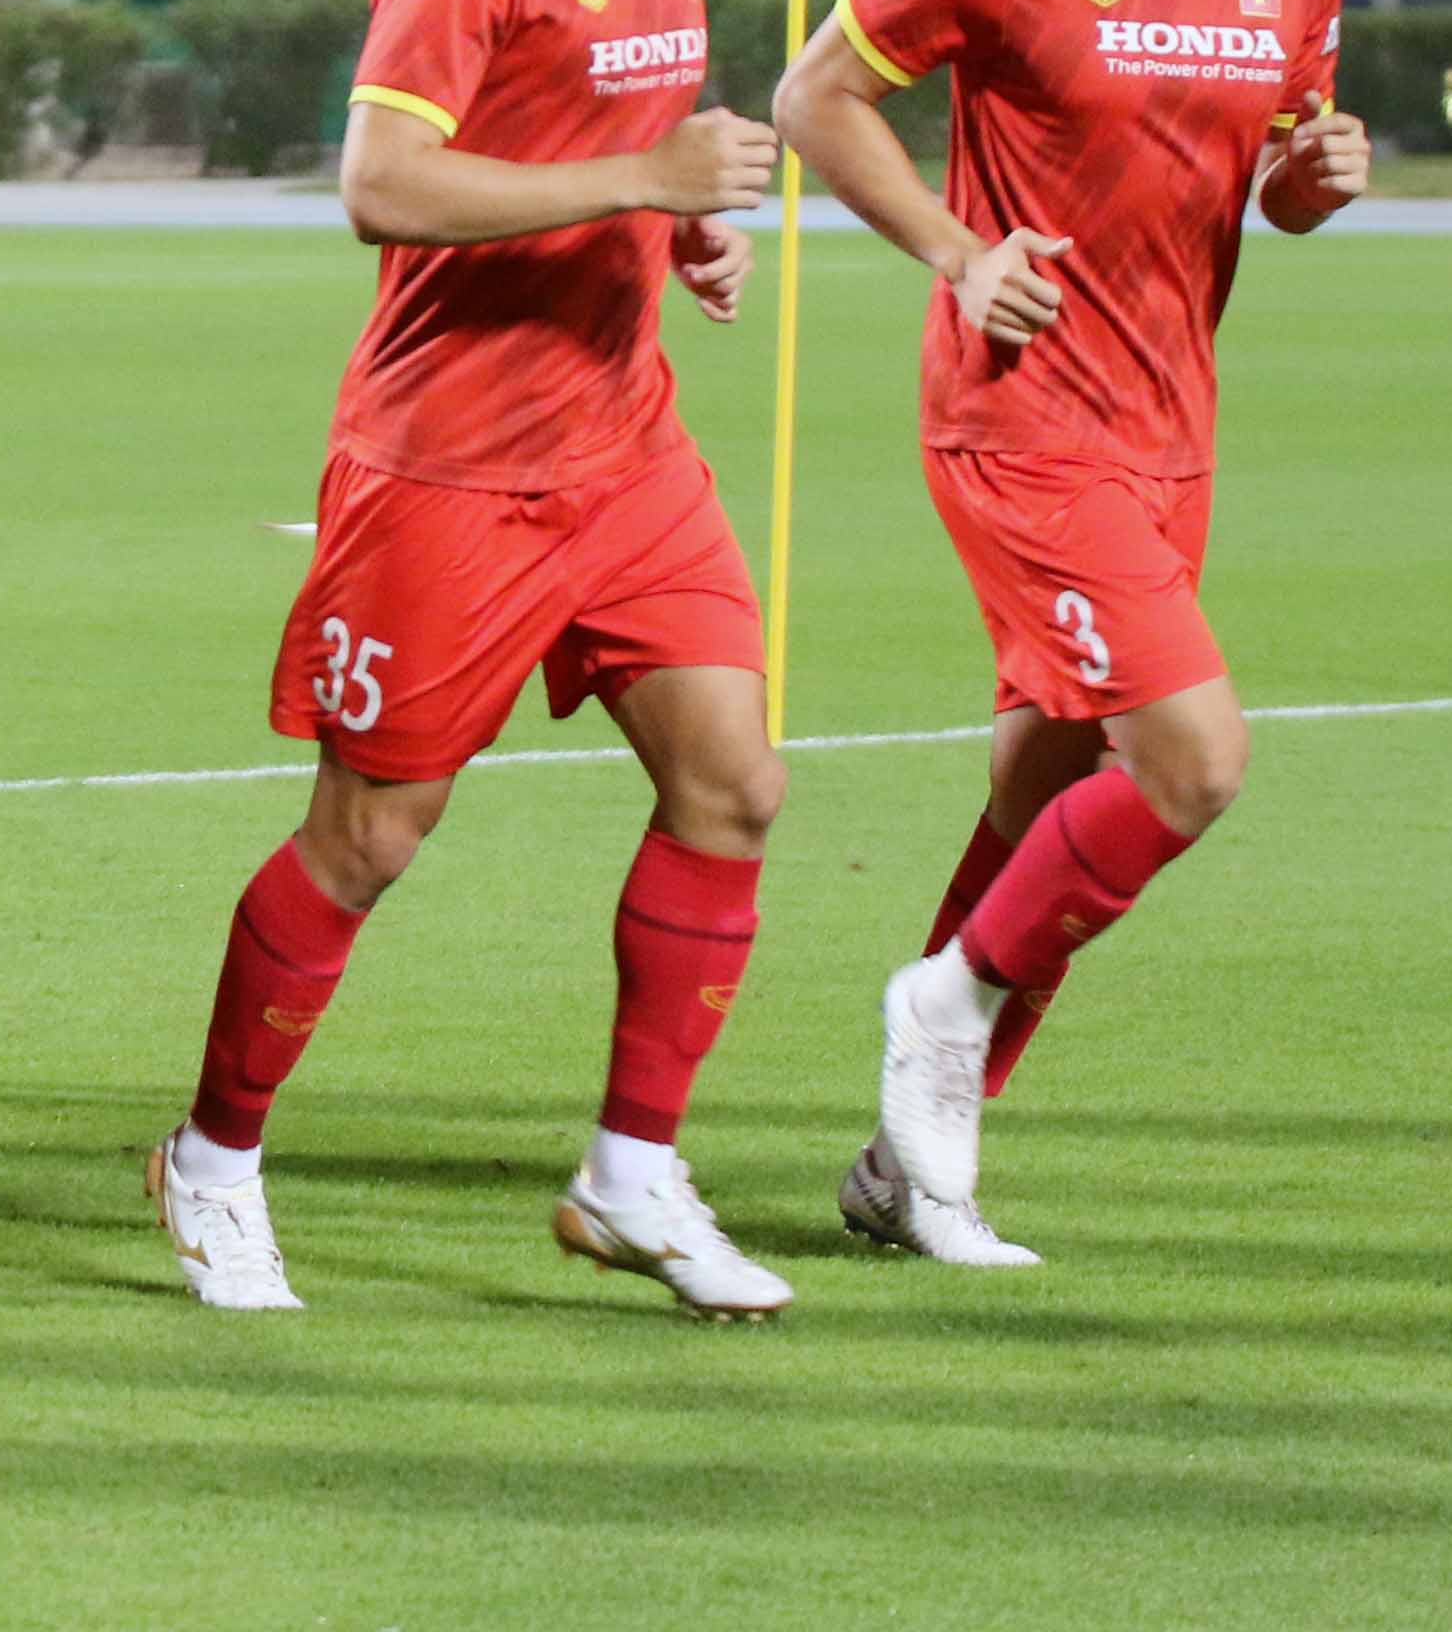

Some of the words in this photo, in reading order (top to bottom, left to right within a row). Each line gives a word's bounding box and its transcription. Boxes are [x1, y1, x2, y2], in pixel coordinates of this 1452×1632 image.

[1096, 19, 1287, 60] HONDA
[1105, 57, 1144, 75] The
[1145, 60, 1197, 78] Power
[1201, 61, 1221, 79] of
[1224, 64, 1283, 83] Dreams
[1055, 589, 1111, 684] 3
[312, 616, 394, 732] 35
